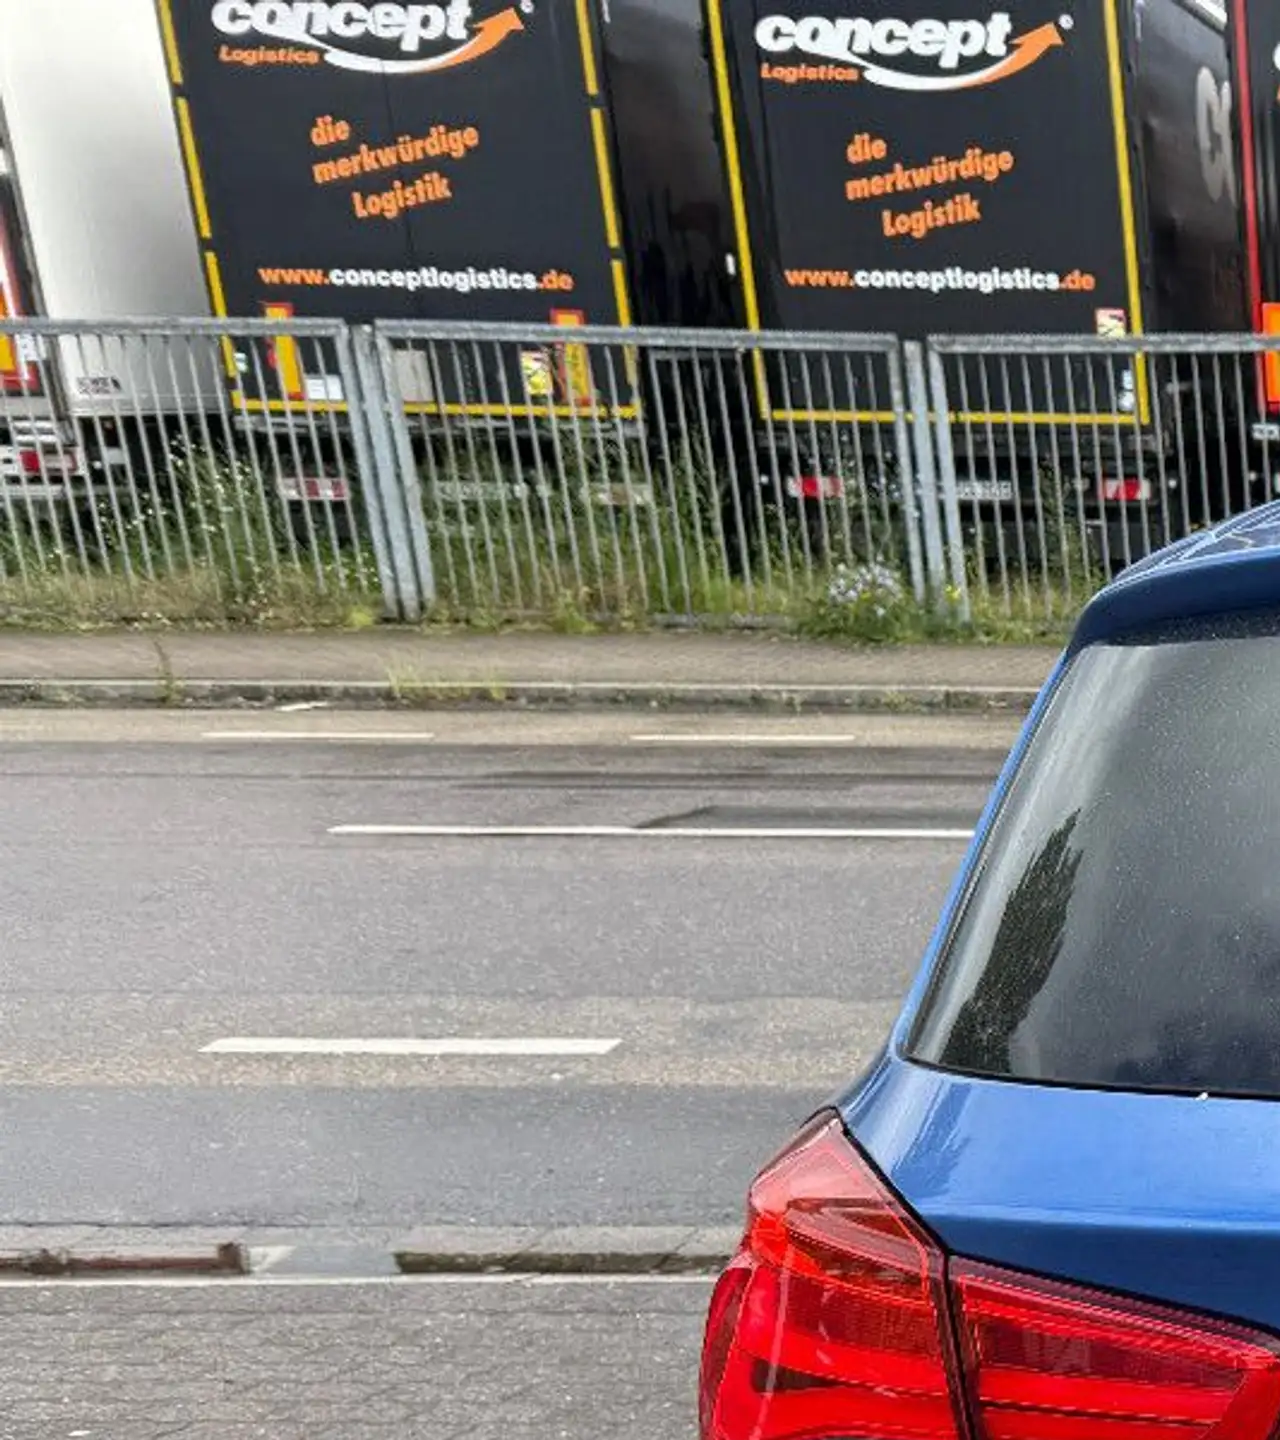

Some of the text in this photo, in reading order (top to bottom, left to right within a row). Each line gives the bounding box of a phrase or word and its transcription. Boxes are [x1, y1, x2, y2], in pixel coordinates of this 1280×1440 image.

[211, 0, 471, 51] concept
[755, 13, 1012, 68] concept
[219, 46, 320, 66] Logistics
[760, 62, 860, 84] Logistics
[310, 116, 350, 146] die
[846, 133, 887, 164] die
[311, 124, 480, 184] merkwürdige
[845, 146, 1014, 202] merkwürdige
[351, 173, 452, 219] Logistik
[882, 194, 981, 238] Logistik
[257, 265, 575, 294] www.conceptlogistics.de
[784, 266, 1096, 295] www.conceptlogistics.de
